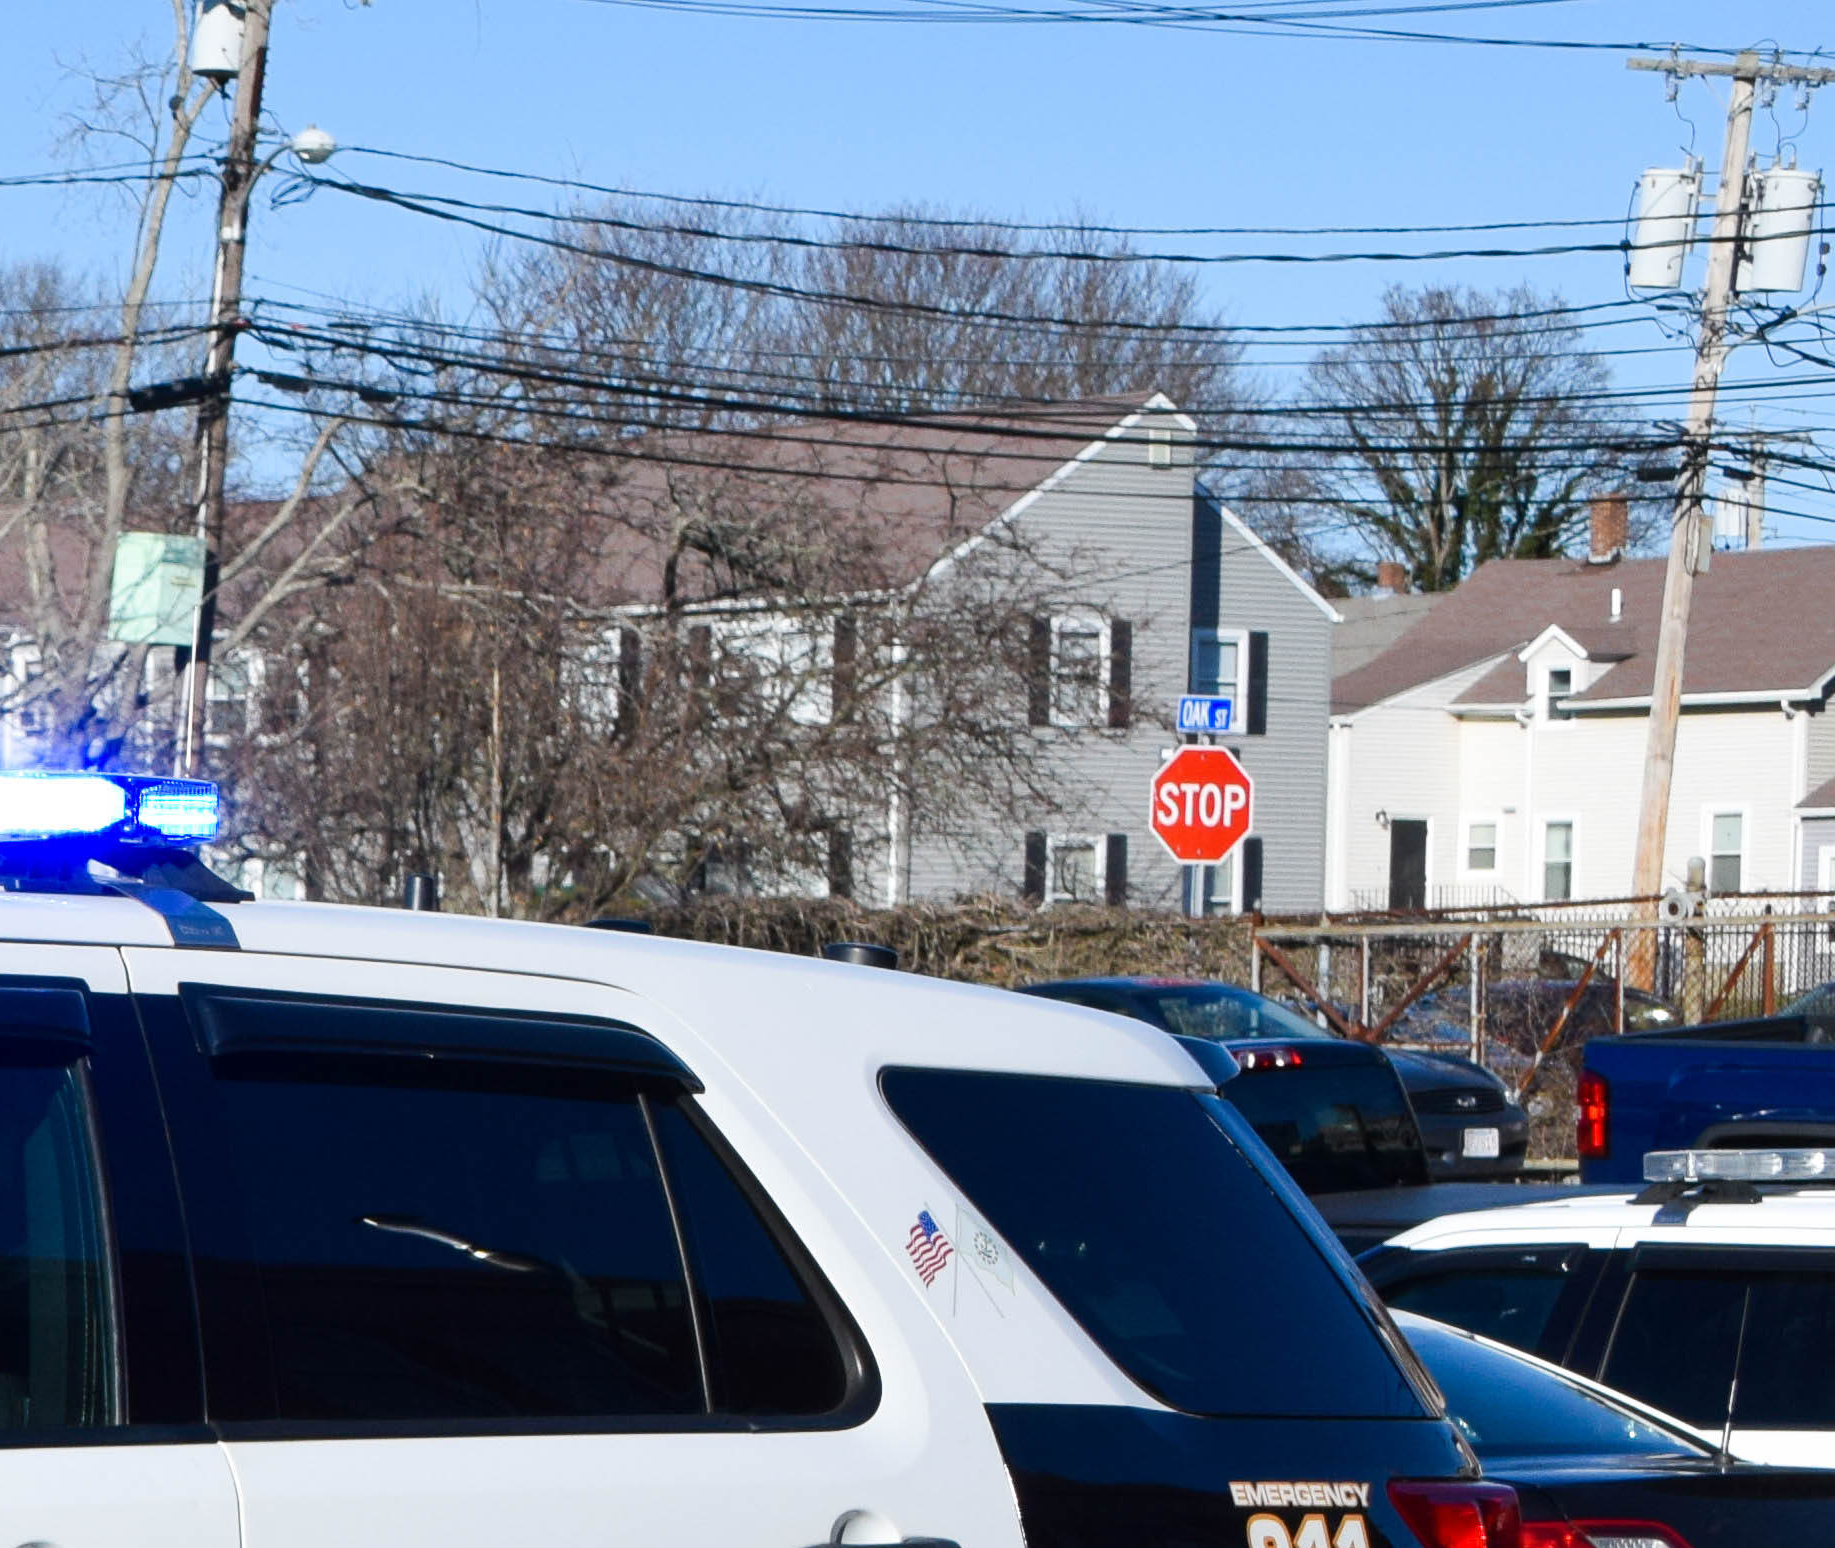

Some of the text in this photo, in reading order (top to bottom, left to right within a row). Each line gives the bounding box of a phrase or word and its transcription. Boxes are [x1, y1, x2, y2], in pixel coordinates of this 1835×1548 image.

[1182, 700, 1228, 729] OAK ST
[1157, 782, 1246, 828] STOP
[1228, 1481, 1371, 1508] EMERGENCY
